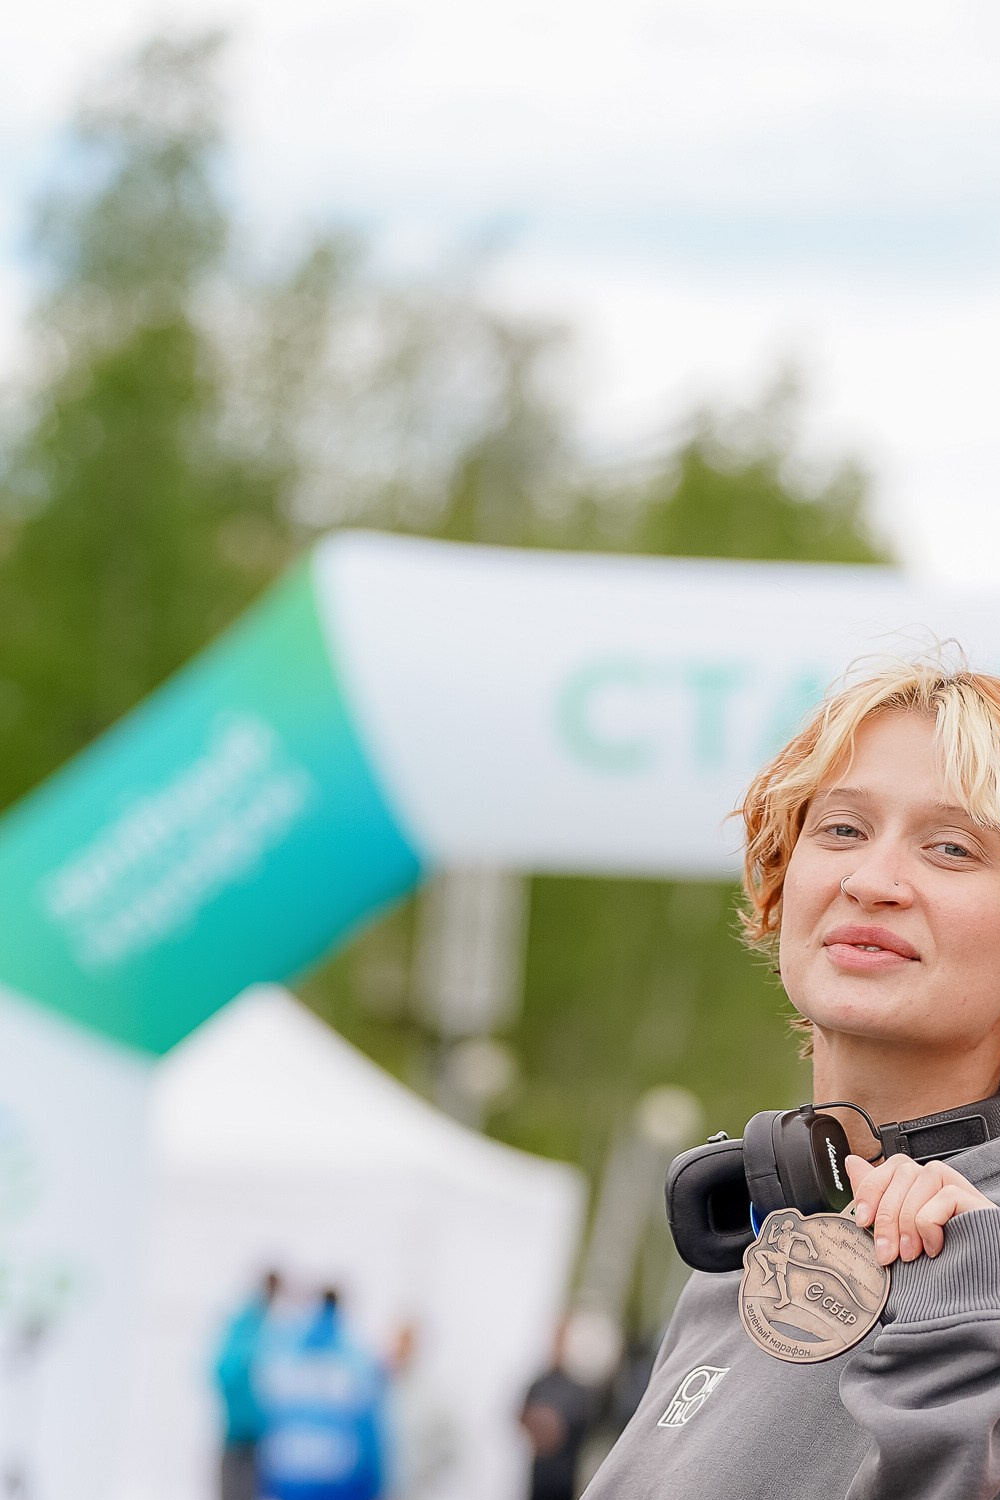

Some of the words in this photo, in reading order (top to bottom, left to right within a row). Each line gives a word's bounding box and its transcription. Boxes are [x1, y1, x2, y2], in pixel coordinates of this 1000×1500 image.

[746, 1303, 773, 1341] зелёный
[769, 1336, 812, 1357] марафон
[822, 1296, 857, 1325] СБЕР
